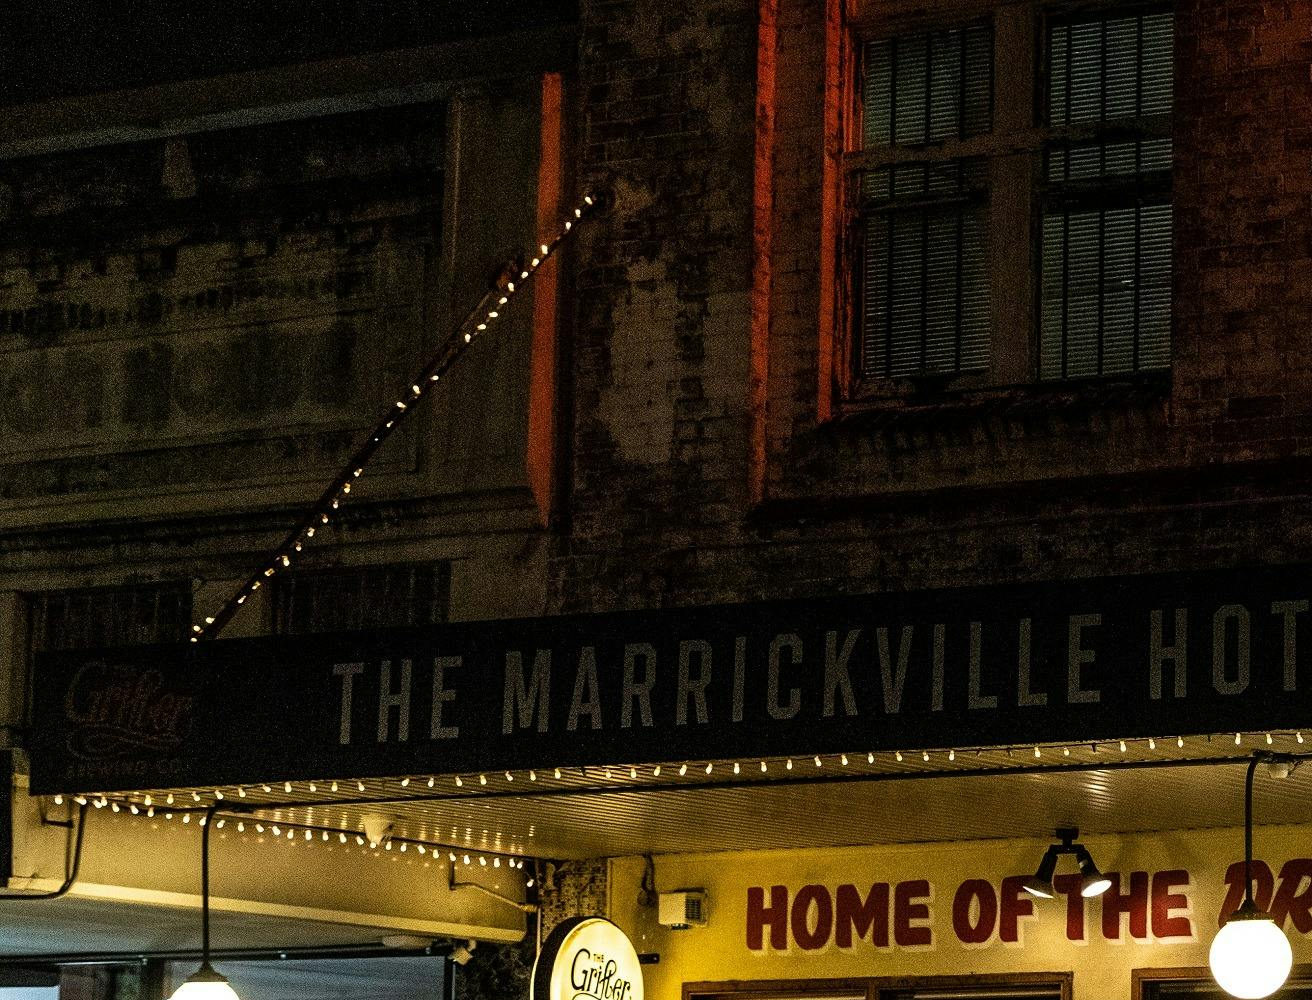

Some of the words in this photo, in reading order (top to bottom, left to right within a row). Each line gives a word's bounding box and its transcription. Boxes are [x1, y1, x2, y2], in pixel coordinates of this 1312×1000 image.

[332, 655, 465, 744] THE
[502, 613, 1102, 735] MARRICKVILLE
[746, 879, 933, 952] HOME
[952, 874, 1037, 944] OF
[1053, 869, 1194, 941] THE
[593, 954, 604, 963] THE
